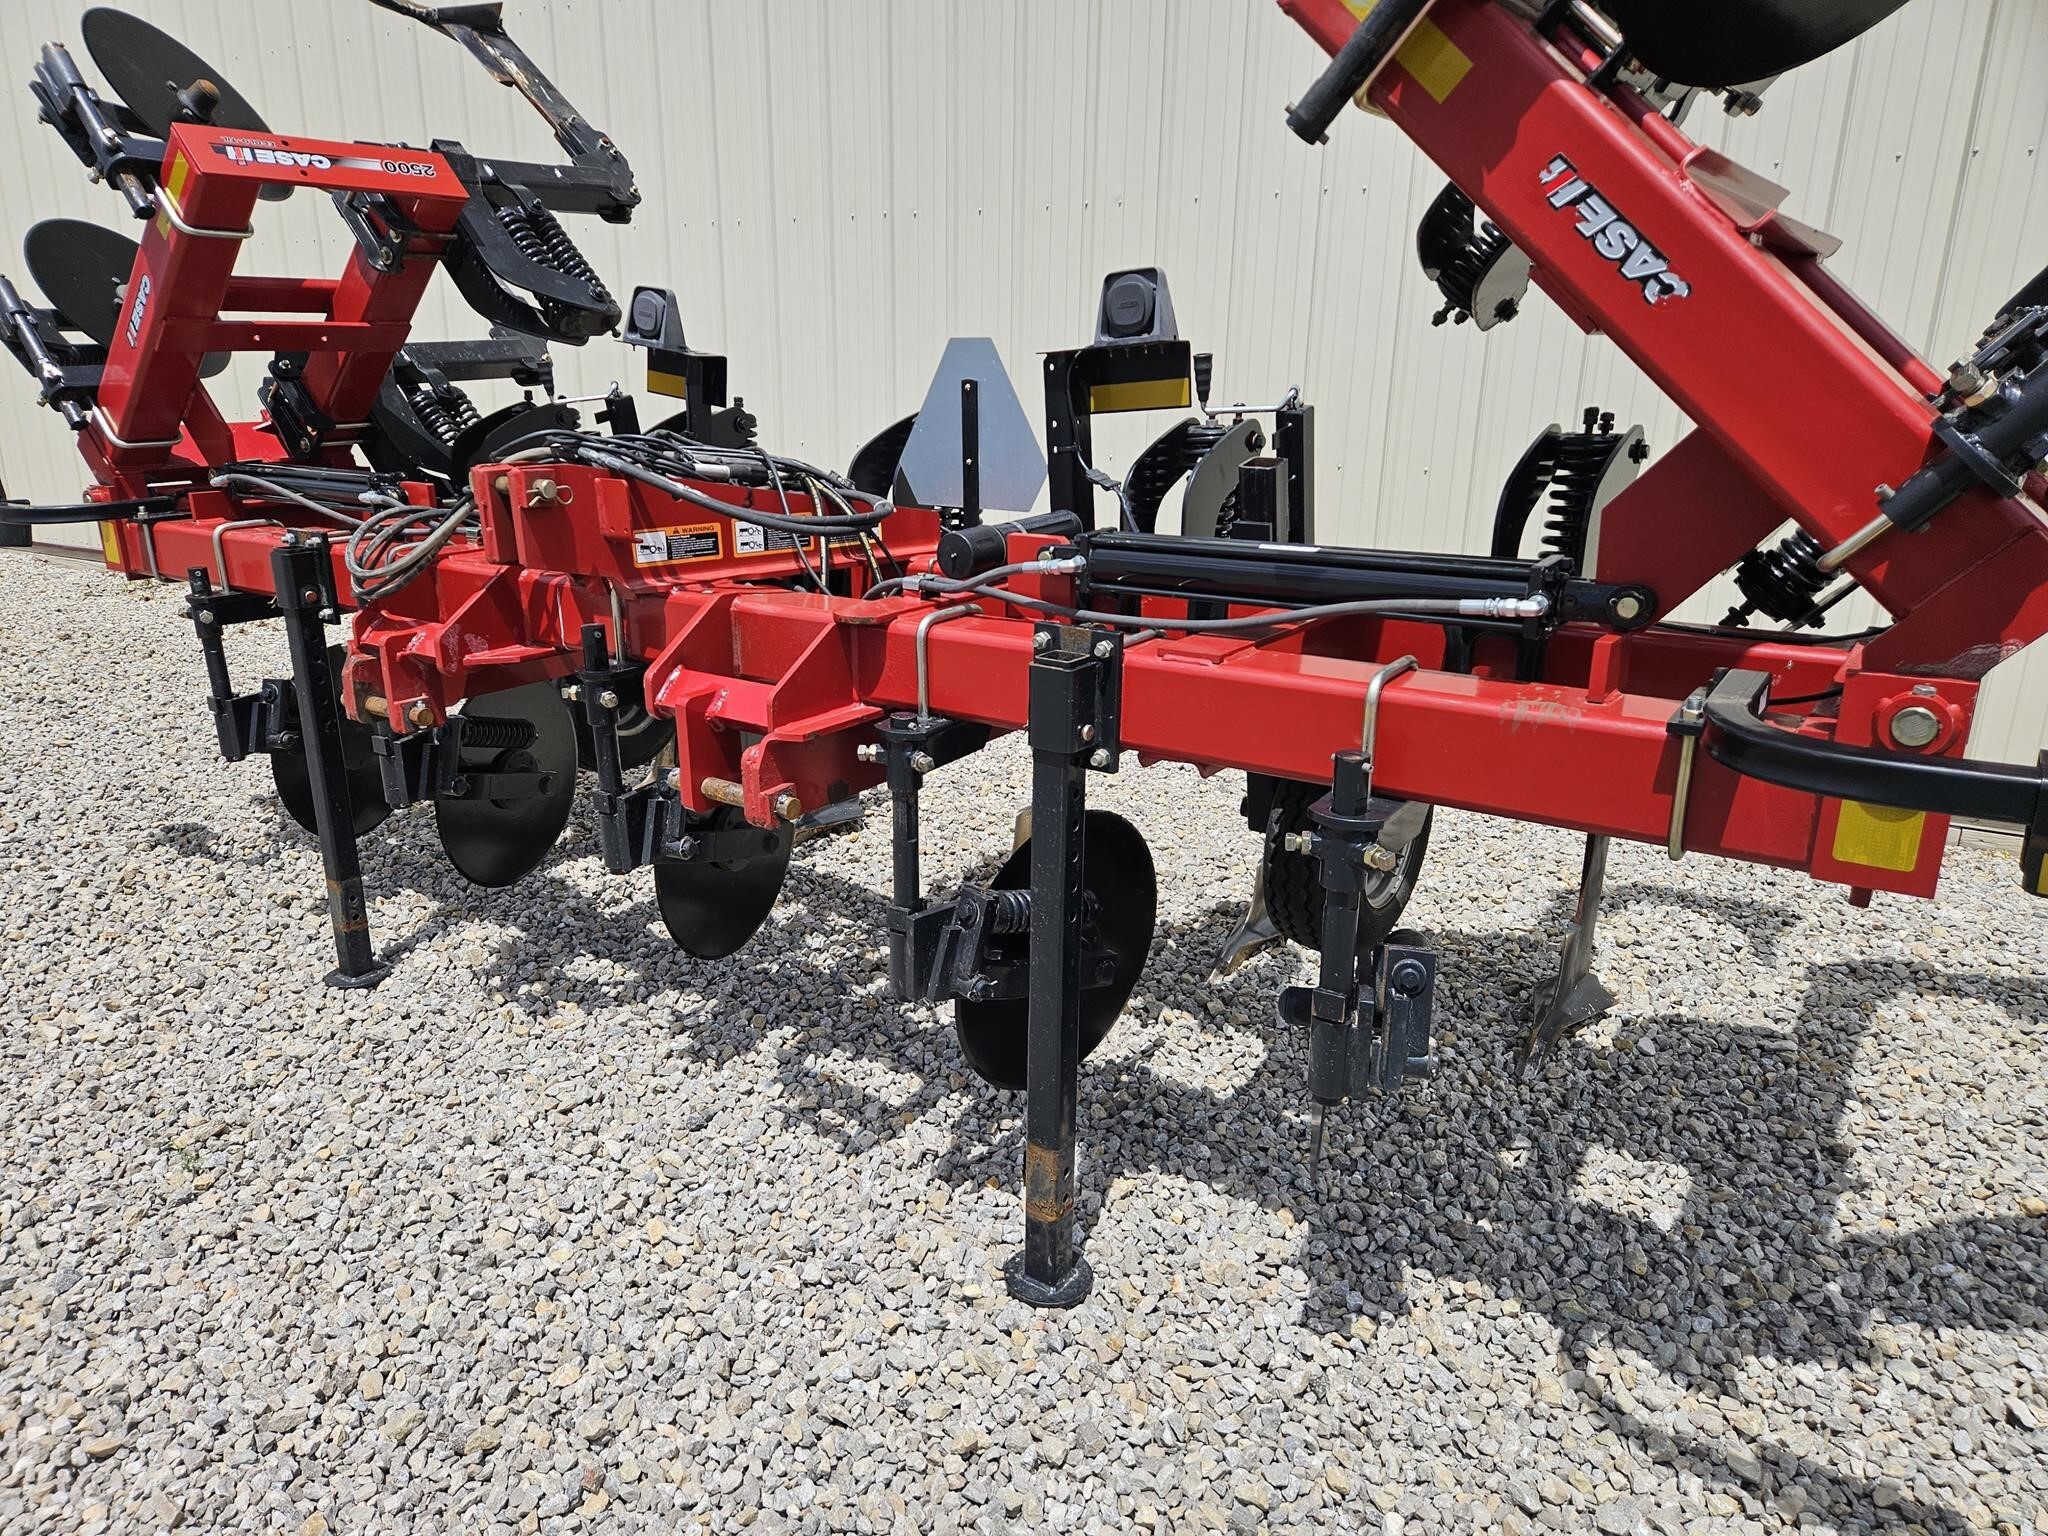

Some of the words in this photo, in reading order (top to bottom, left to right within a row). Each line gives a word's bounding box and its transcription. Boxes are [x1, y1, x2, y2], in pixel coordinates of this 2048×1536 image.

[255, 148, 331, 170] CASE
[384, 159, 435, 177] 2500
[1576, 194, 1690, 303] CASE
[681, 525, 714, 533] WARNING
